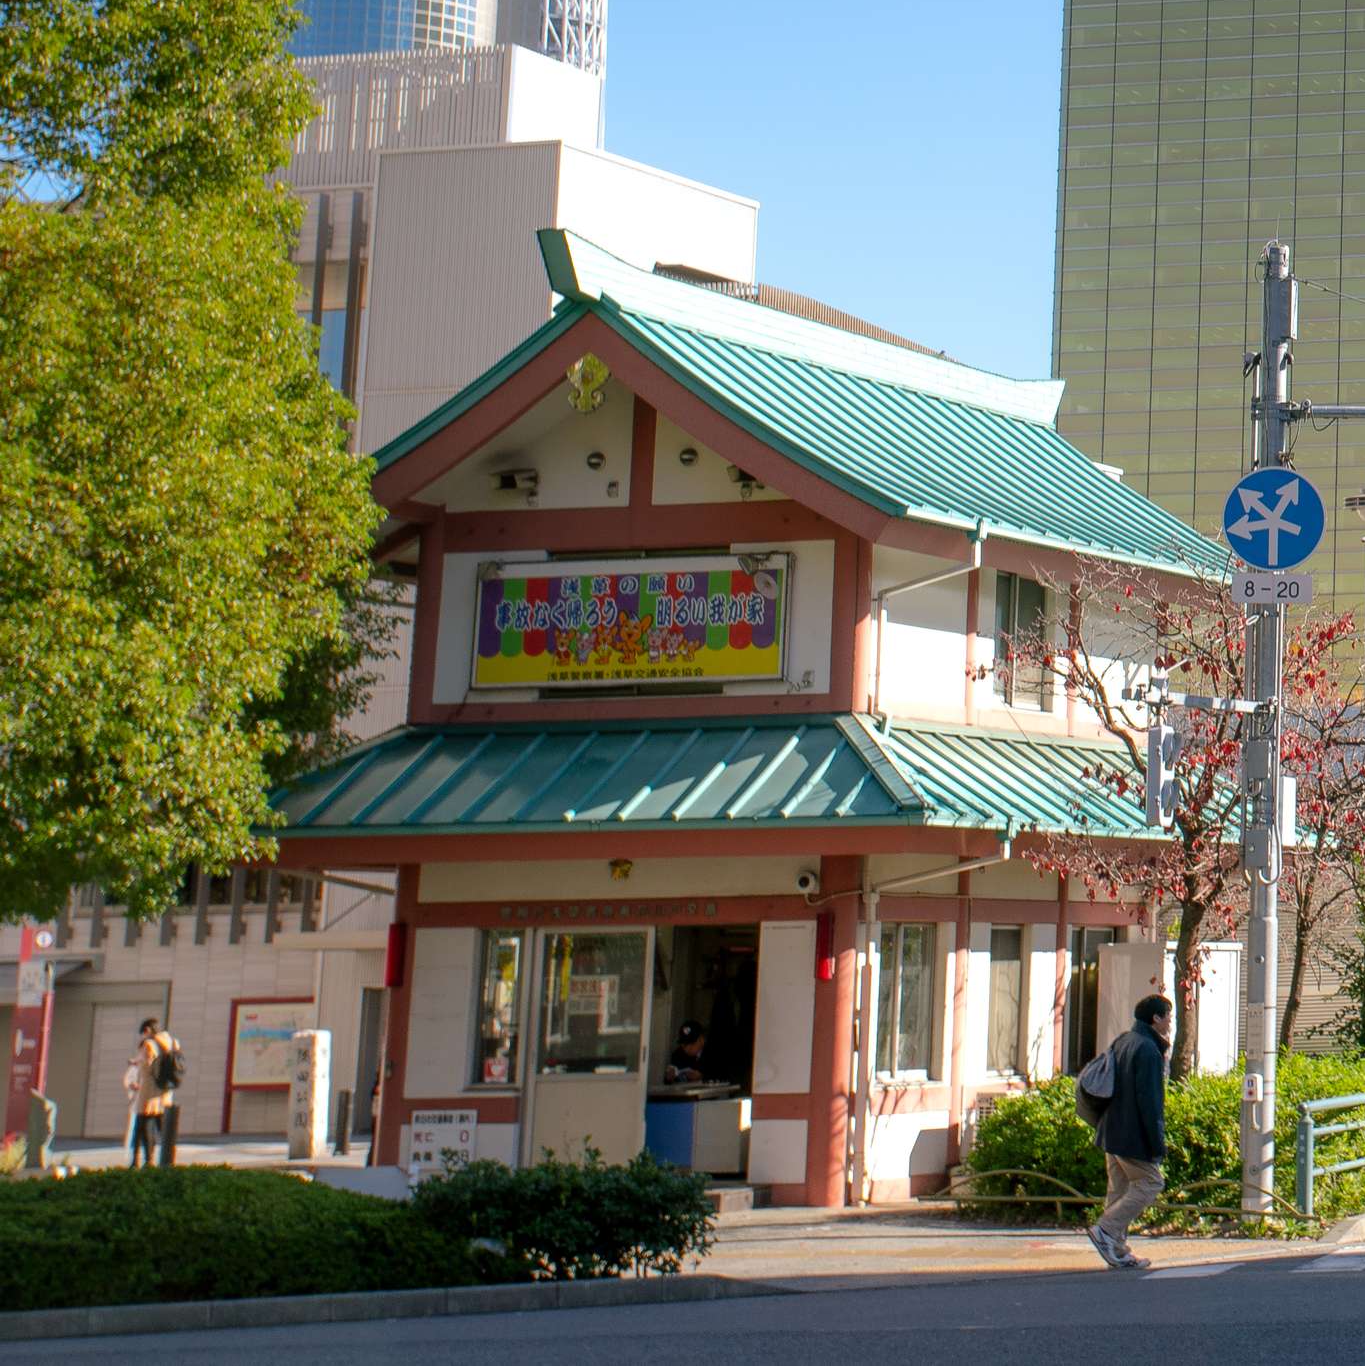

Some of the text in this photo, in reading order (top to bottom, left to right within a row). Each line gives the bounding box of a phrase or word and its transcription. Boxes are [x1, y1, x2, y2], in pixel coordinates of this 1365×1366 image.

[560, 574, 695, 597] 浅草の願い
[495, 593, 765, 633] 事故なく帰ろう 明るい我が家
